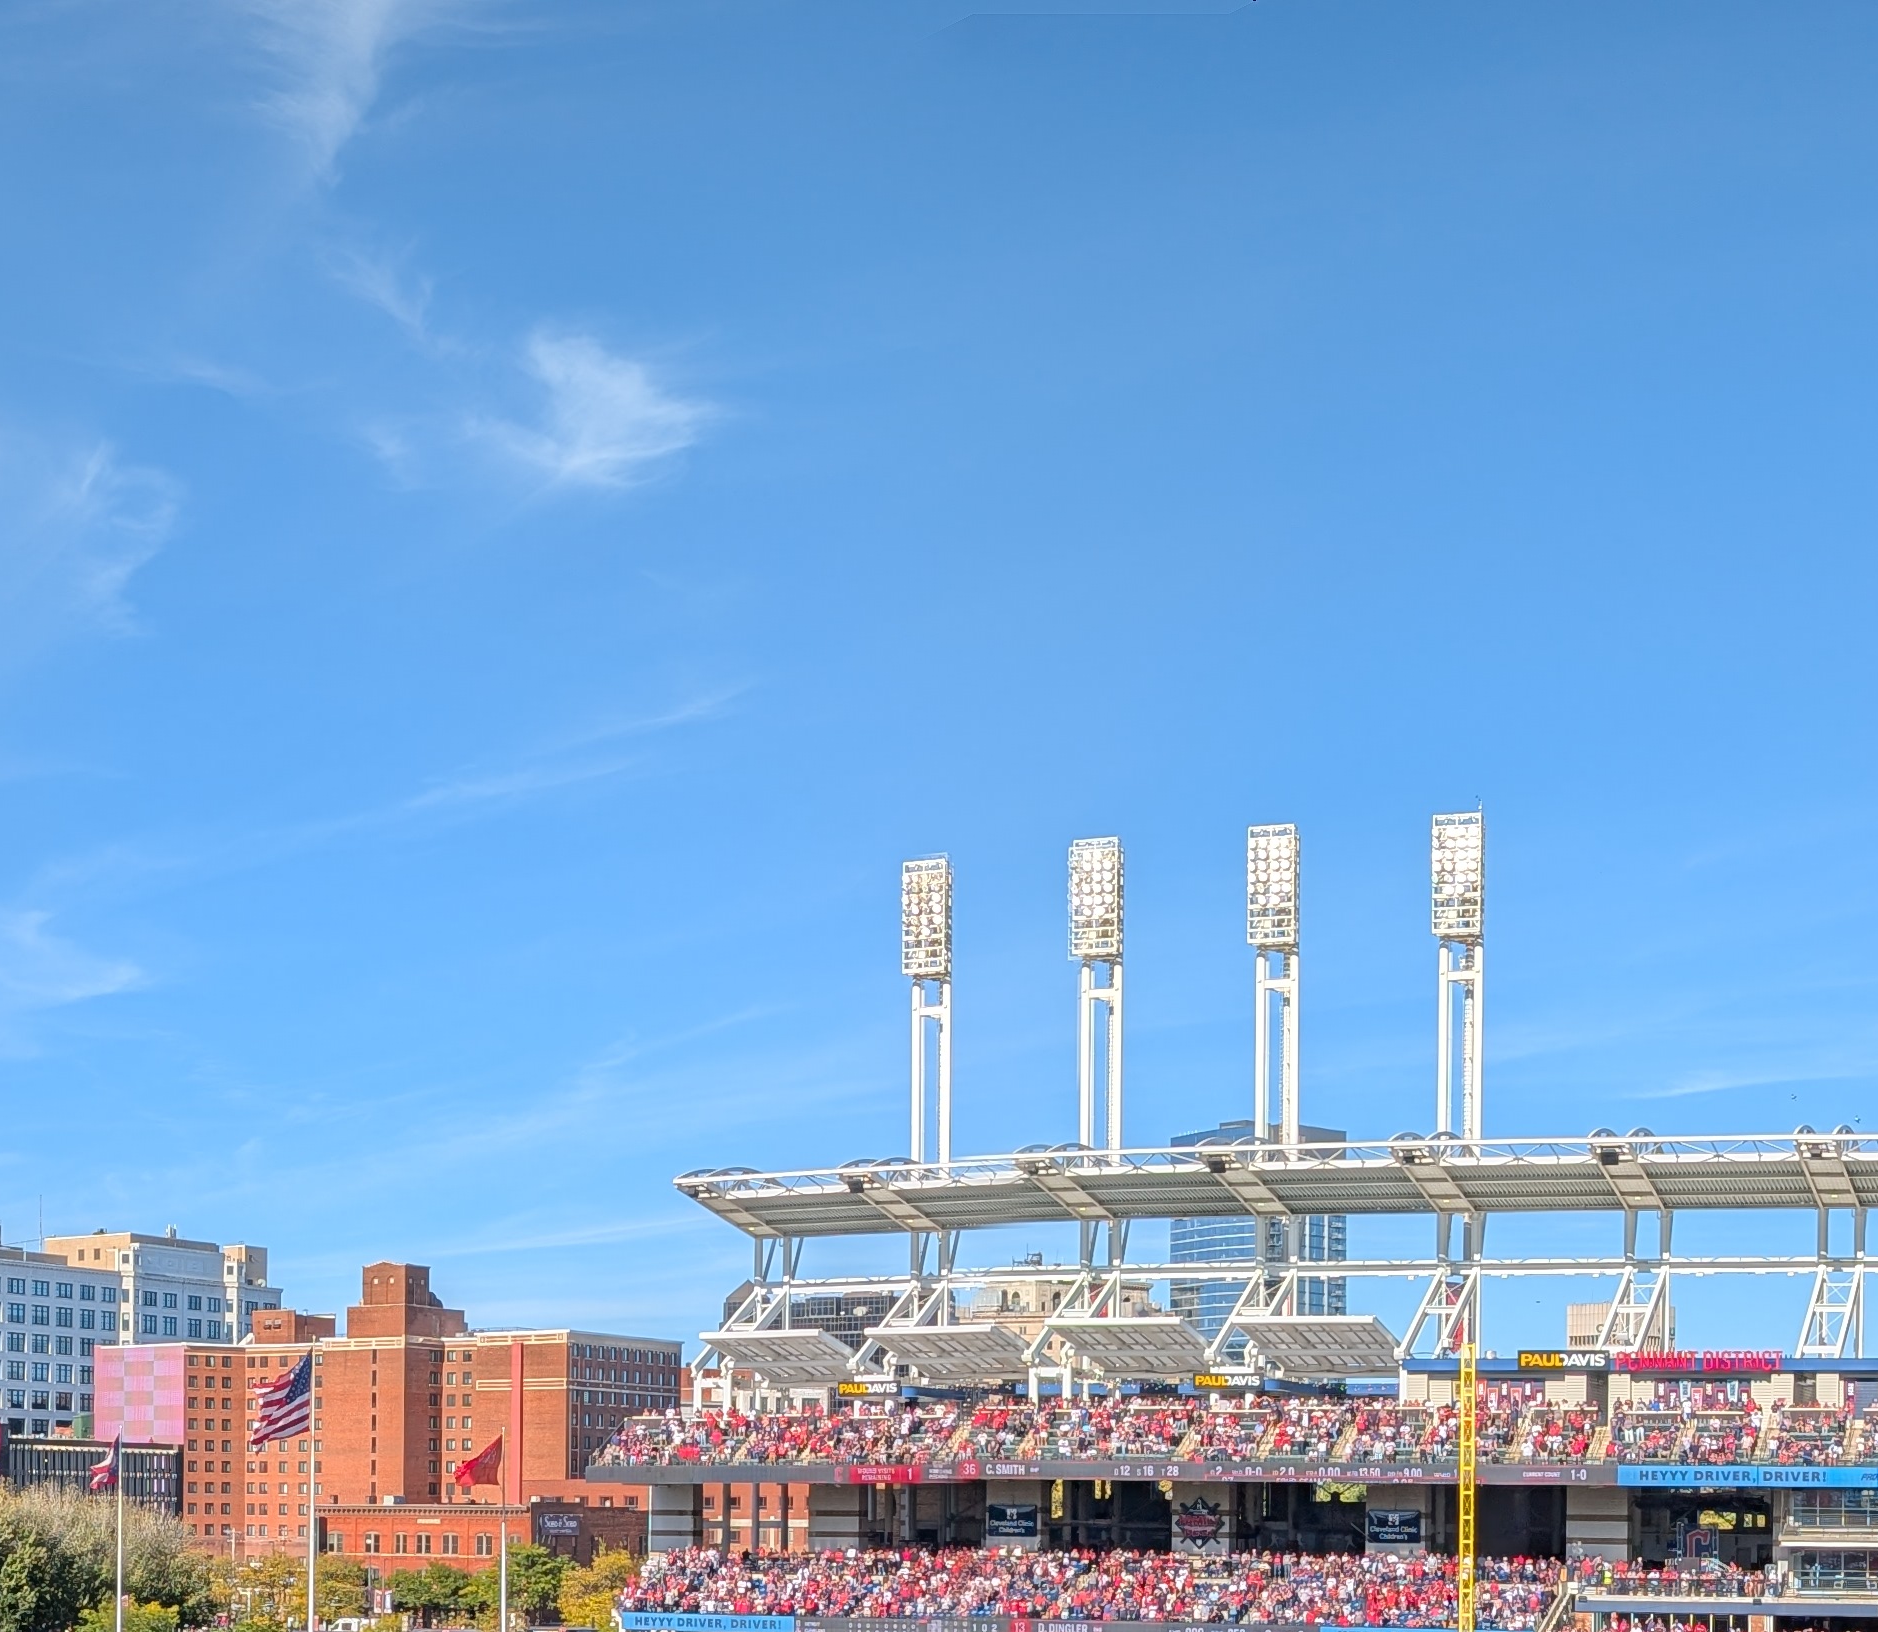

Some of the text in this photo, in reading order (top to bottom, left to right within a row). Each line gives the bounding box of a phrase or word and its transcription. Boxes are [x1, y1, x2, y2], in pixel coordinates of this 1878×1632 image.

[1702, 1350, 1784, 1371] DISTRICT
[997, 1464, 1025, 1475] SMITH
[1639, 1470, 1827, 1483] HEYYY DRIVER, DRIVER!
[635, 1616, 781, 1631] HEYYY DRIVER, DRIVER!
